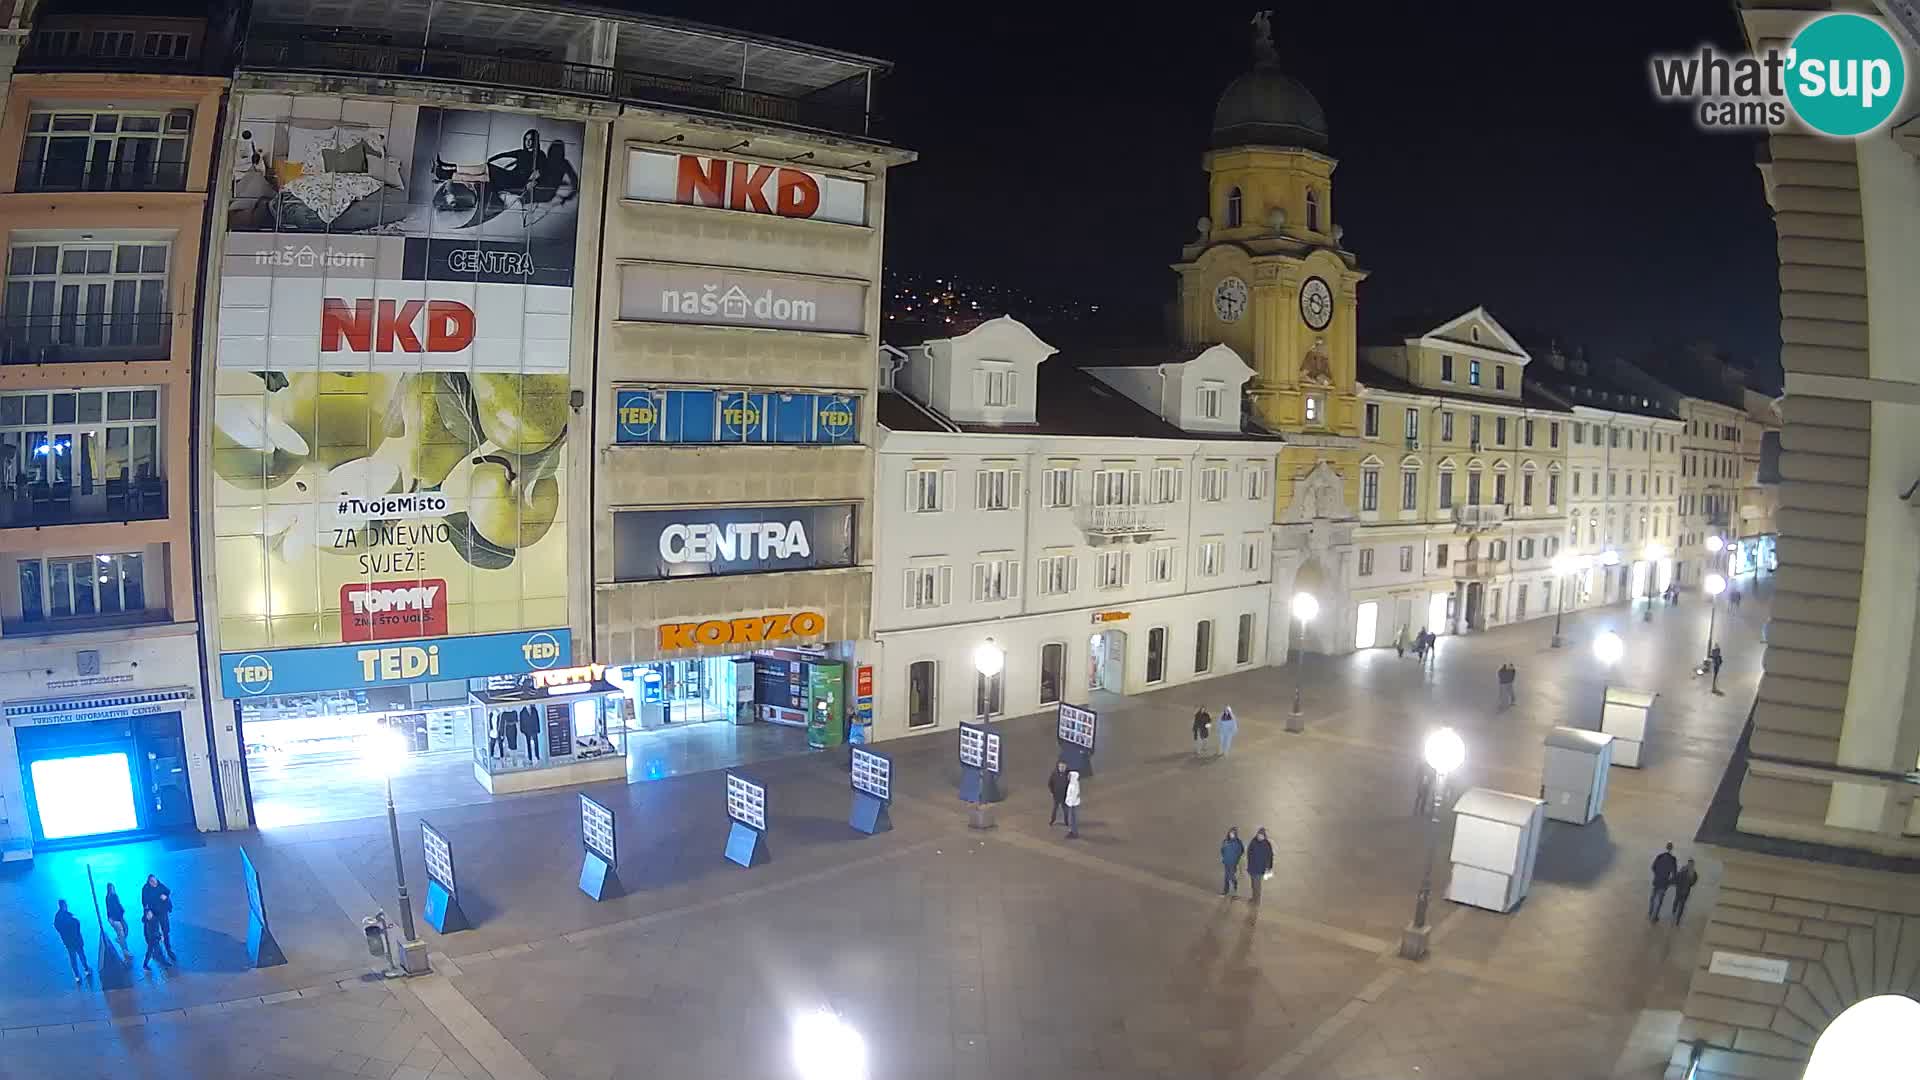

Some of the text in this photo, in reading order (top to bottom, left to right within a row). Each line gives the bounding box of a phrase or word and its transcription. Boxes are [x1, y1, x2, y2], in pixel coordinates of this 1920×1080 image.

[676, 153, 820, 218] NKD
[255, 245, 366, 269] naš dom
[448, 248, 534, 275] CENTRA
[661, 284, 816, 322] naš dom
[321, 297, 477, 353] NKD
[619, 407, 657, 425] TEDi
[723, 409, 760, 426] TEDi
[820, 411, 853, 426] TEDi
[338, 496, 446, 515] #TvojeMisto
[333, 523, 450, 548] ZA DNEVNO
[659, 520, 811, 564] CENTRA
[360, 547, 426, 574] SVJEŽE
[348, 586, 439, 614] TOMMY
[659, 612, 824, 650] KORZO
[357, 646, 440, 682] TEDi
[522, 643, 560, 660] TEDi
[234, 666, 273, 683] TEDi
